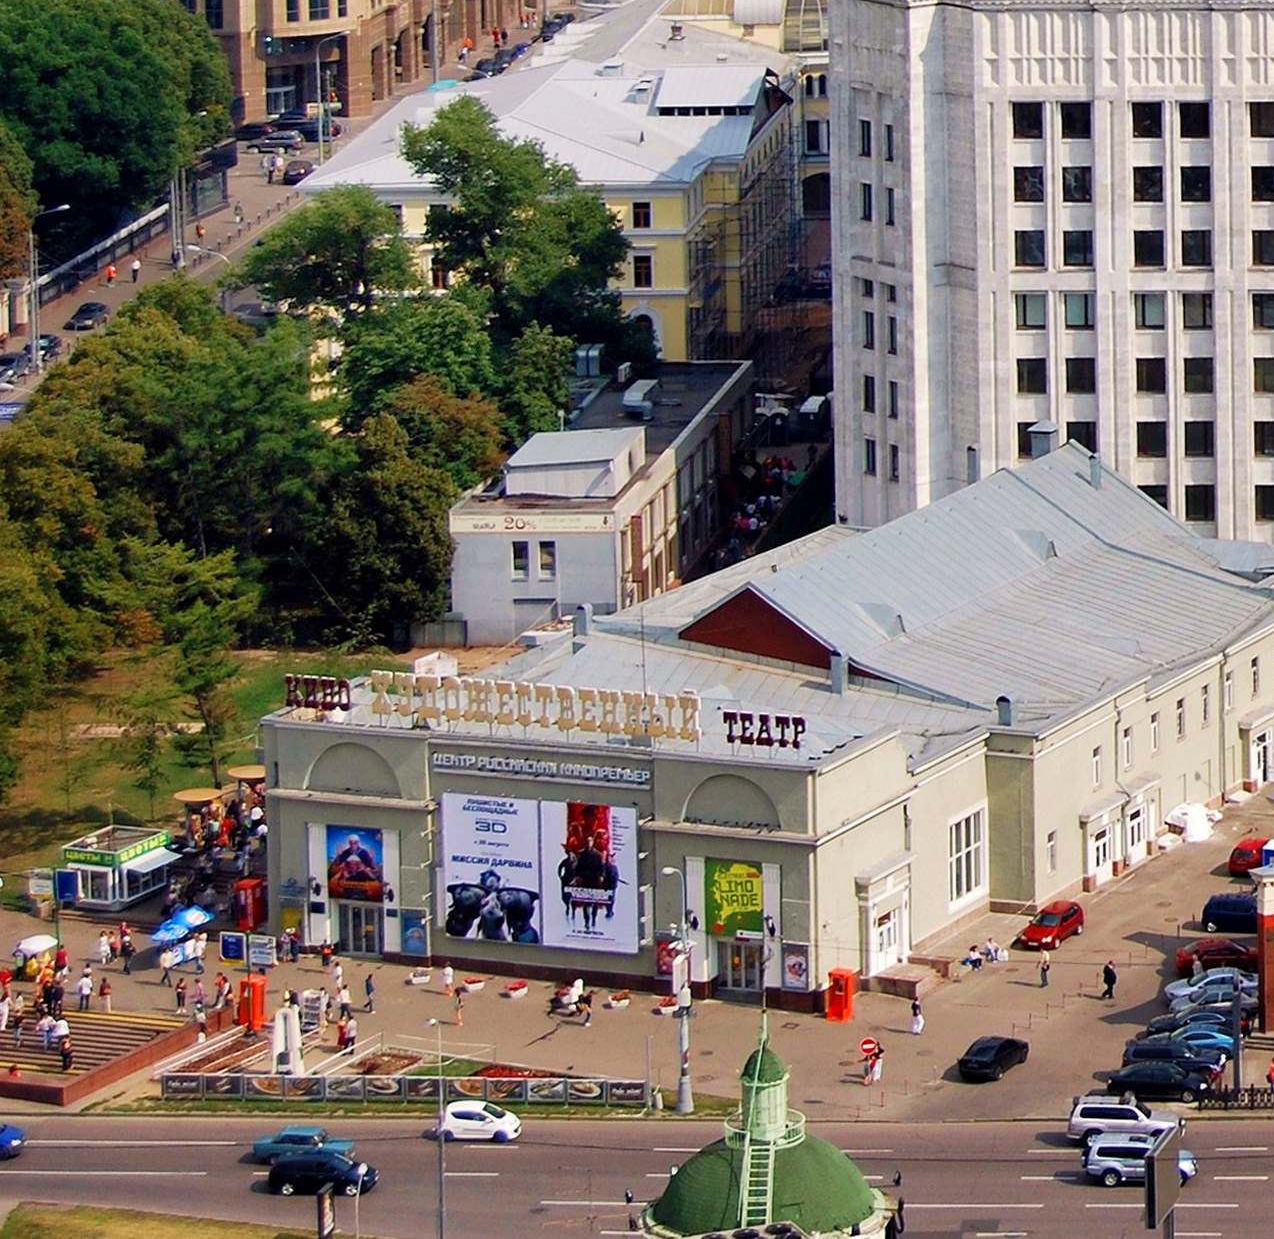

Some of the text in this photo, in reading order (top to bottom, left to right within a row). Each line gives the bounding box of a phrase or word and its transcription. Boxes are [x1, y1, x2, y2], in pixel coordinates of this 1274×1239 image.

[284, 669, 808, 749] КИНО ХУДОЖЕСТВЕННЫЙ ТЕАТР
[432, 752, 476, 768] ЦЕНТР
[475, 821, 507, 834] 3D
[451, 854, 533, 869] МИССИЯ ДАРВИНА
[718, 879, 754, 894] LIMO
[719, 893, 760, 907] NADE
